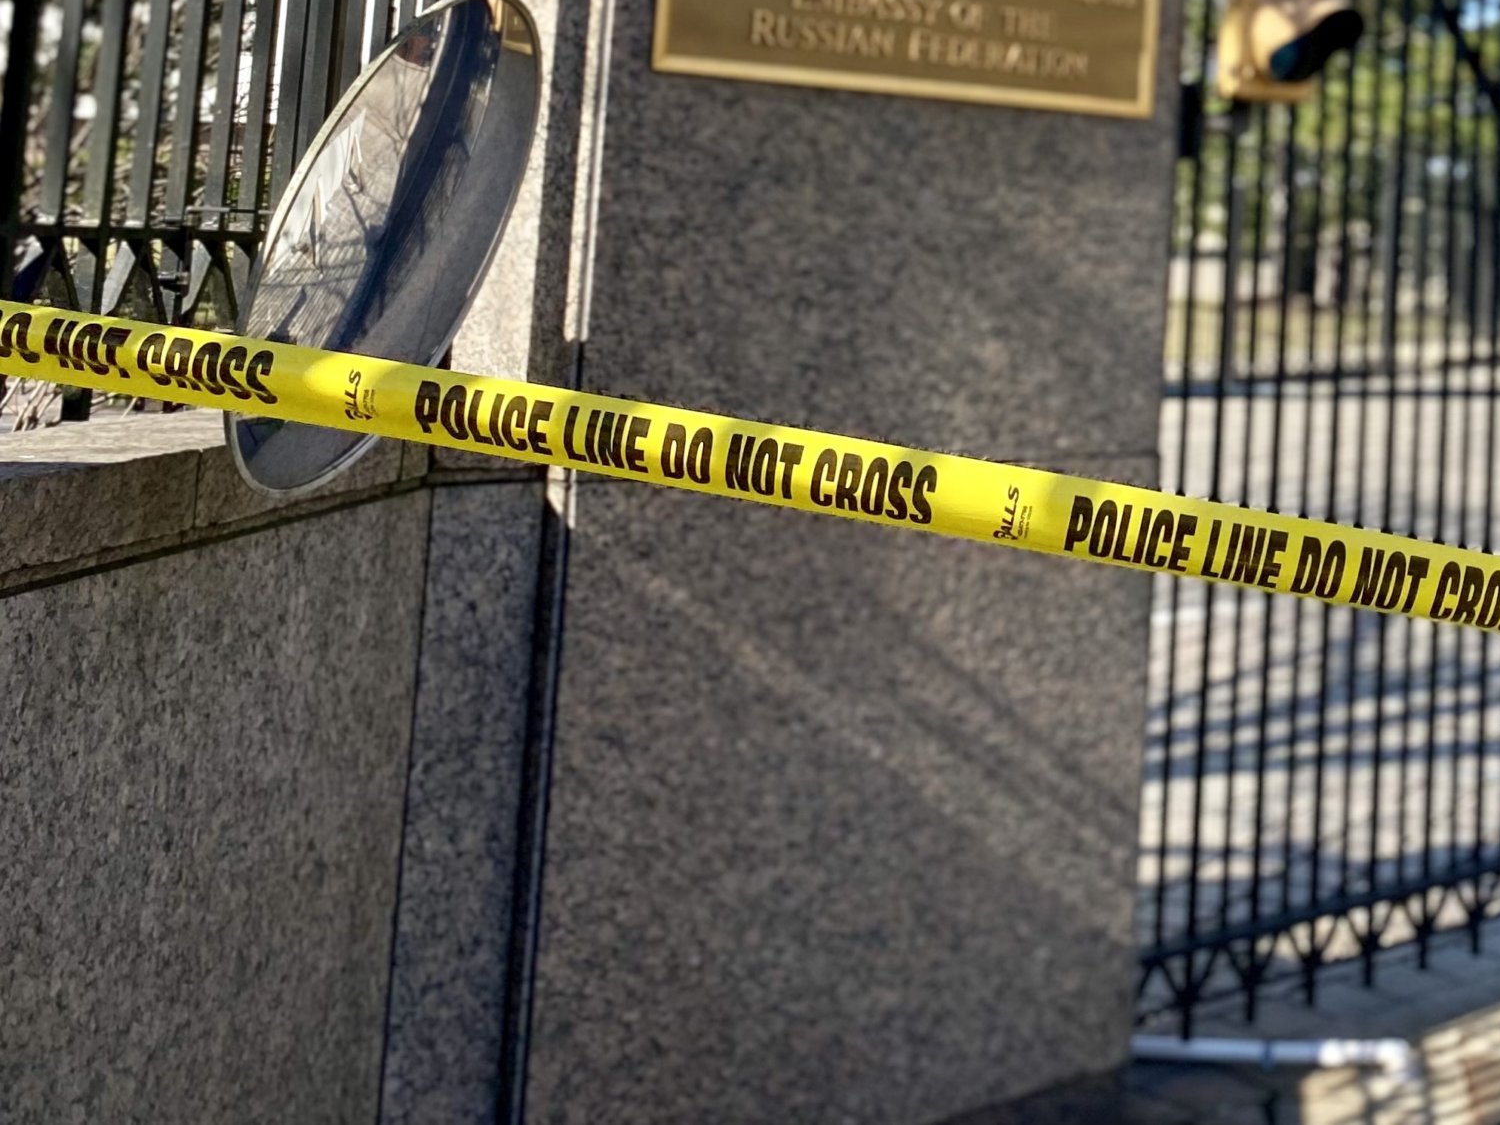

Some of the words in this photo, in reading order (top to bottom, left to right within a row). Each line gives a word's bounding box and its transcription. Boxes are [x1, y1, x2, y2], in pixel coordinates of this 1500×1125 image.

[948, 0, 984, 32] OF
[0, 310, 40, 363] O
[44, 318, 131, 379] NOT
[137, 333, 278, 404] CROSS
[415, 380, 553, 456] POLICE
[562, 405, 653, 474] LINE
[661, 423, 714, 484] DO
[725, 433, 806, 500] NOT
[809, 447, 939, 525] CROSS
[1063, 495, 1198, 573] POLICE
[1201, 518, 1289, 589] LINE
[1290, 535, 1347, 600] DO
[1346, 546, 1430, 613] NOT
